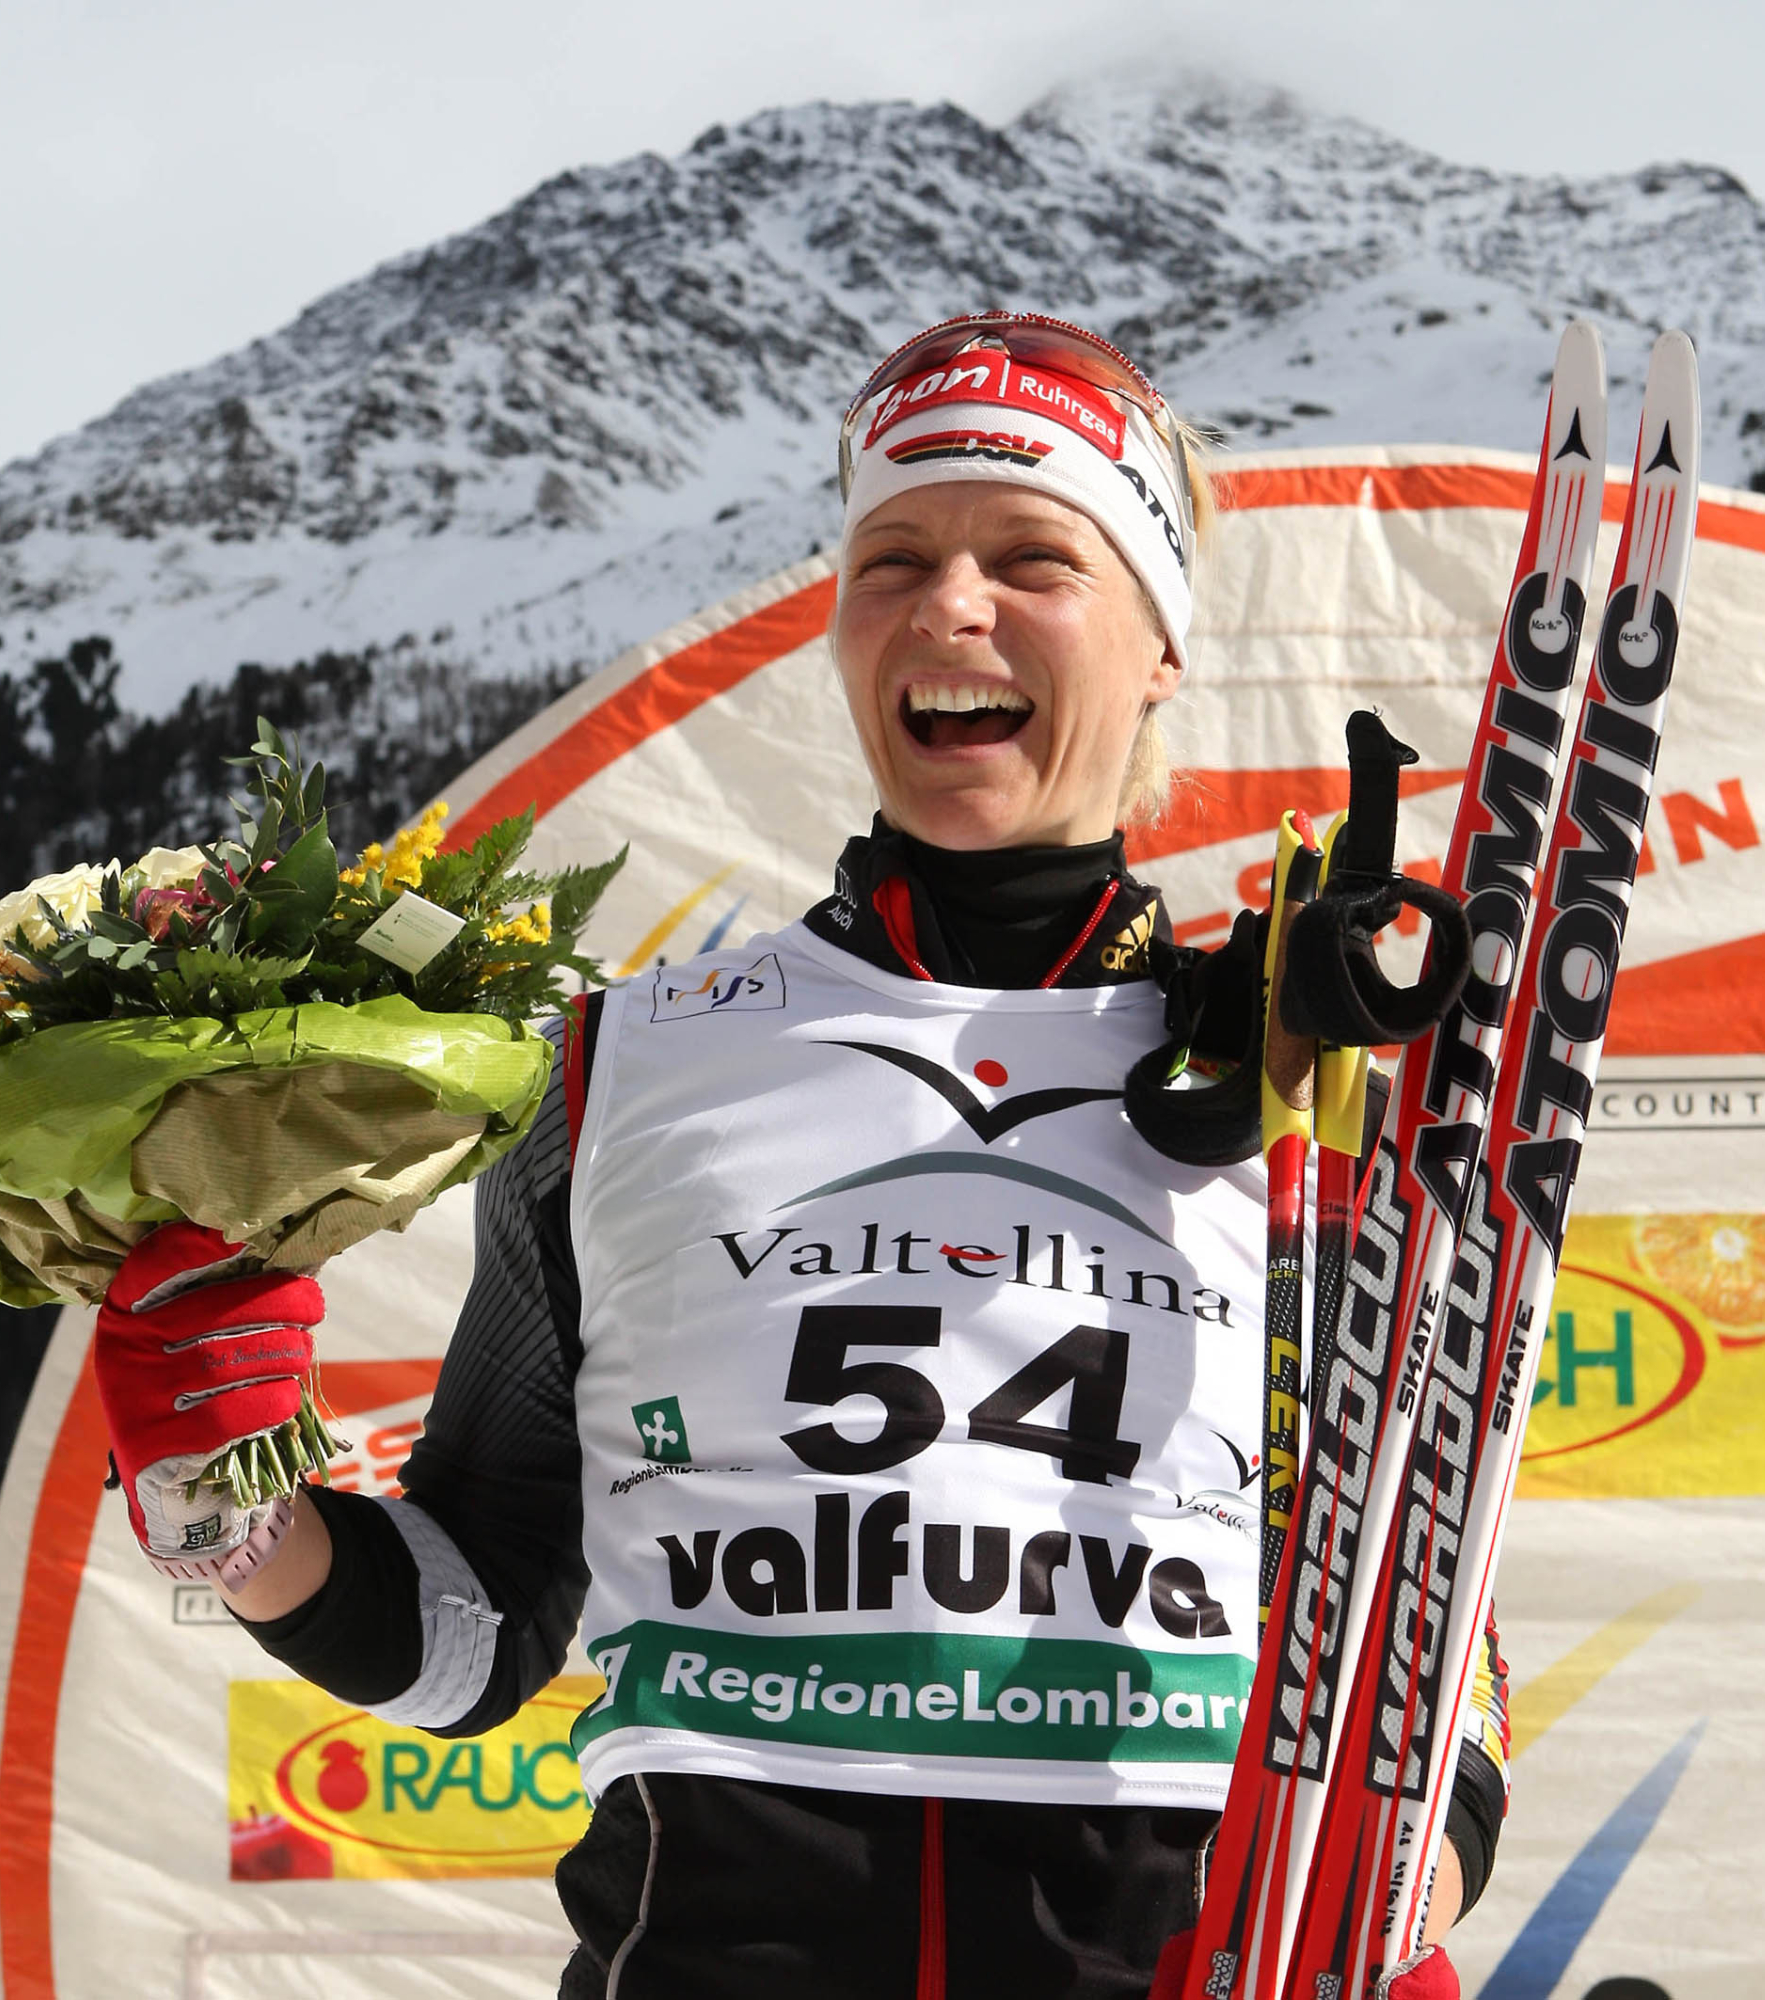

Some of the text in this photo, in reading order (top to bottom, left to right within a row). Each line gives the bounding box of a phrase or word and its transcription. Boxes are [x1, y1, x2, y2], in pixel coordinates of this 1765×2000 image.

[1018, 374, 1118, 446] Ruhrgas
[1415, 571, 1587, 1252] ATOMIC
[1506, 583, 1680, 1277] ATOMIC
[1601, 1092, 1763, 1118] COUNT
[710, 1222, 1236, 1330] Valtellina
[779, 1304, 1141, 1487] 54
[1397, 1281, 1440, 1419] SKATE
[1492, 1299, 1535, 1436] SKATE
[1268, 1335, 1301, 1532] LEKI
[655, 1490, 1232, 1639] valfurva
[382, 1741, 595, 1812] RAUC
